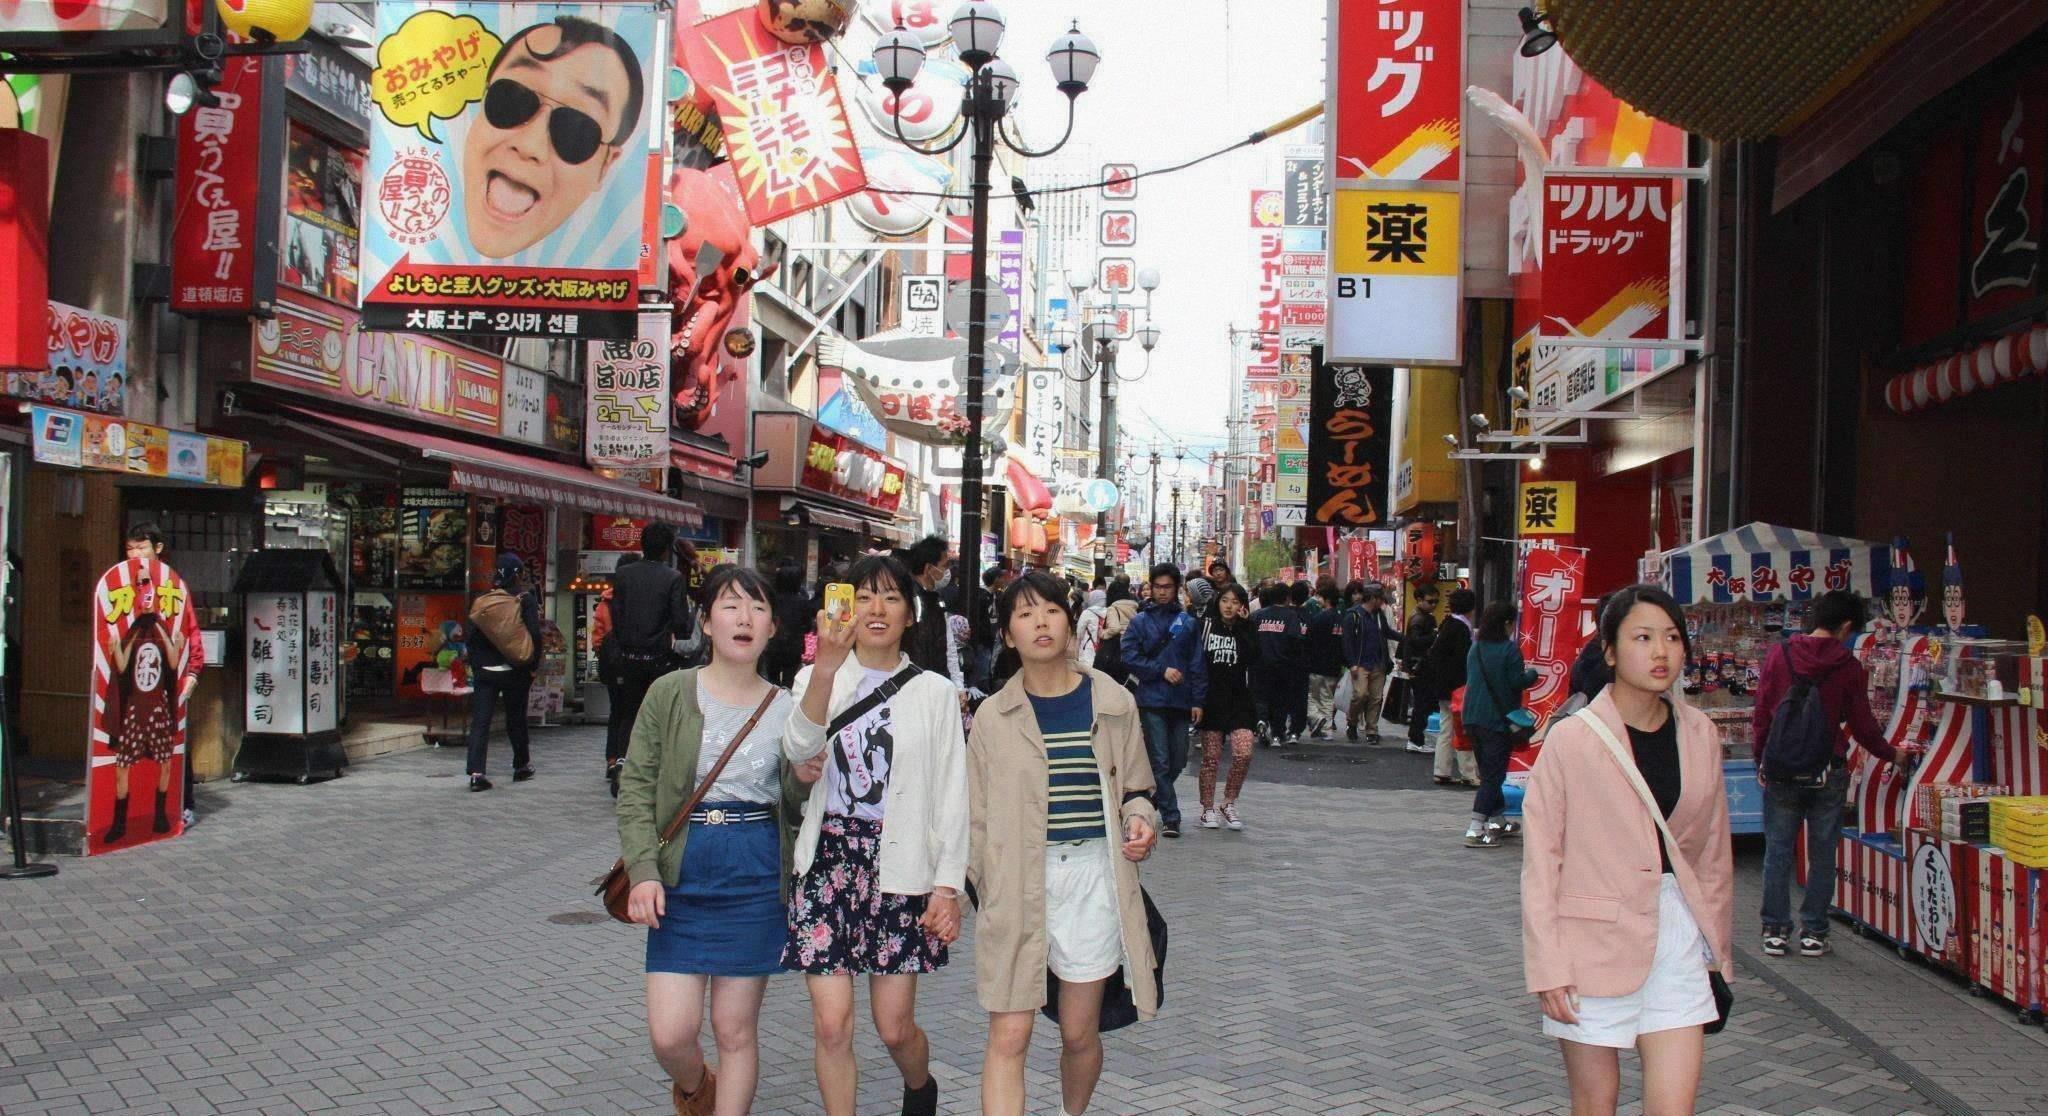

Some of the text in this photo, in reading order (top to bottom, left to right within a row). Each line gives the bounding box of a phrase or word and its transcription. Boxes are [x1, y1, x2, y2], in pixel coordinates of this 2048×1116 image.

[381, 31, 482, 94] おみやげ
[1367, 0, 1434, 118] ッグ
[1549, 184, 1667, 222] ツルハ
[1366, 202, 1428, 264] 薬
[1549, 229, 1644, 255] ドラッグ
[182, 286, 244, 303] 道頓堀店
[387, 272, 629, 300] よしもと芸人グッズ・大阪みやげ
[1258, 233, 1282, 364] ジャンカラ
[1337, 277, 1372, 299] B1
[547, 313, 580, 334] 선물
[346, 322, 456, 416] GAME
[596, 364, 662, 390] 旨い店
[1316, 408, 1378, 523] らーめん
[1525, 486, 1557, 528] 薬
[1706, 558, 1852, 595] 大阪みやげ
[1213, 649, 1239, 664] CITY
[1924, 850, 1941, 946] くいだおれ
